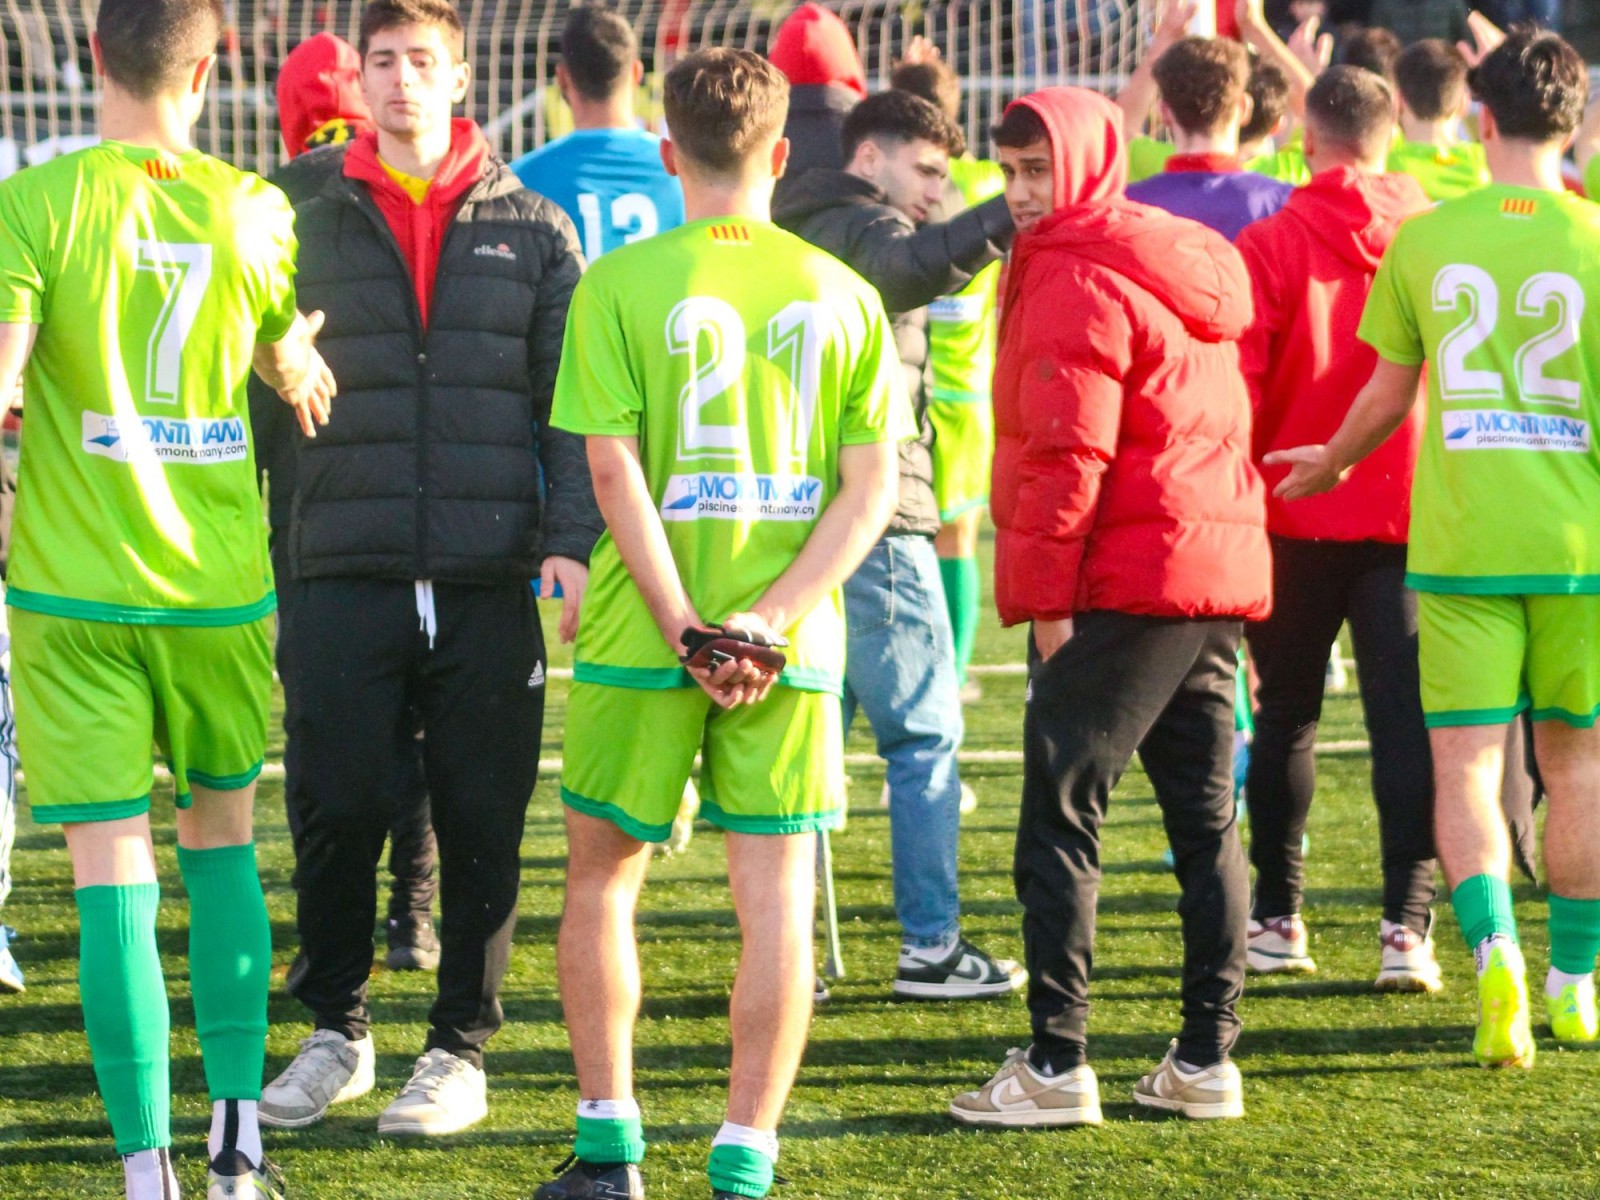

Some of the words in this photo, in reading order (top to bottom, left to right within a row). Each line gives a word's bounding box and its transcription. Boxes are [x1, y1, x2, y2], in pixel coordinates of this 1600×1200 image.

[137, 238, 212, 405] 7
[665, 296, 817, 462] 21
[1432, 264, 1585, 409] 22
